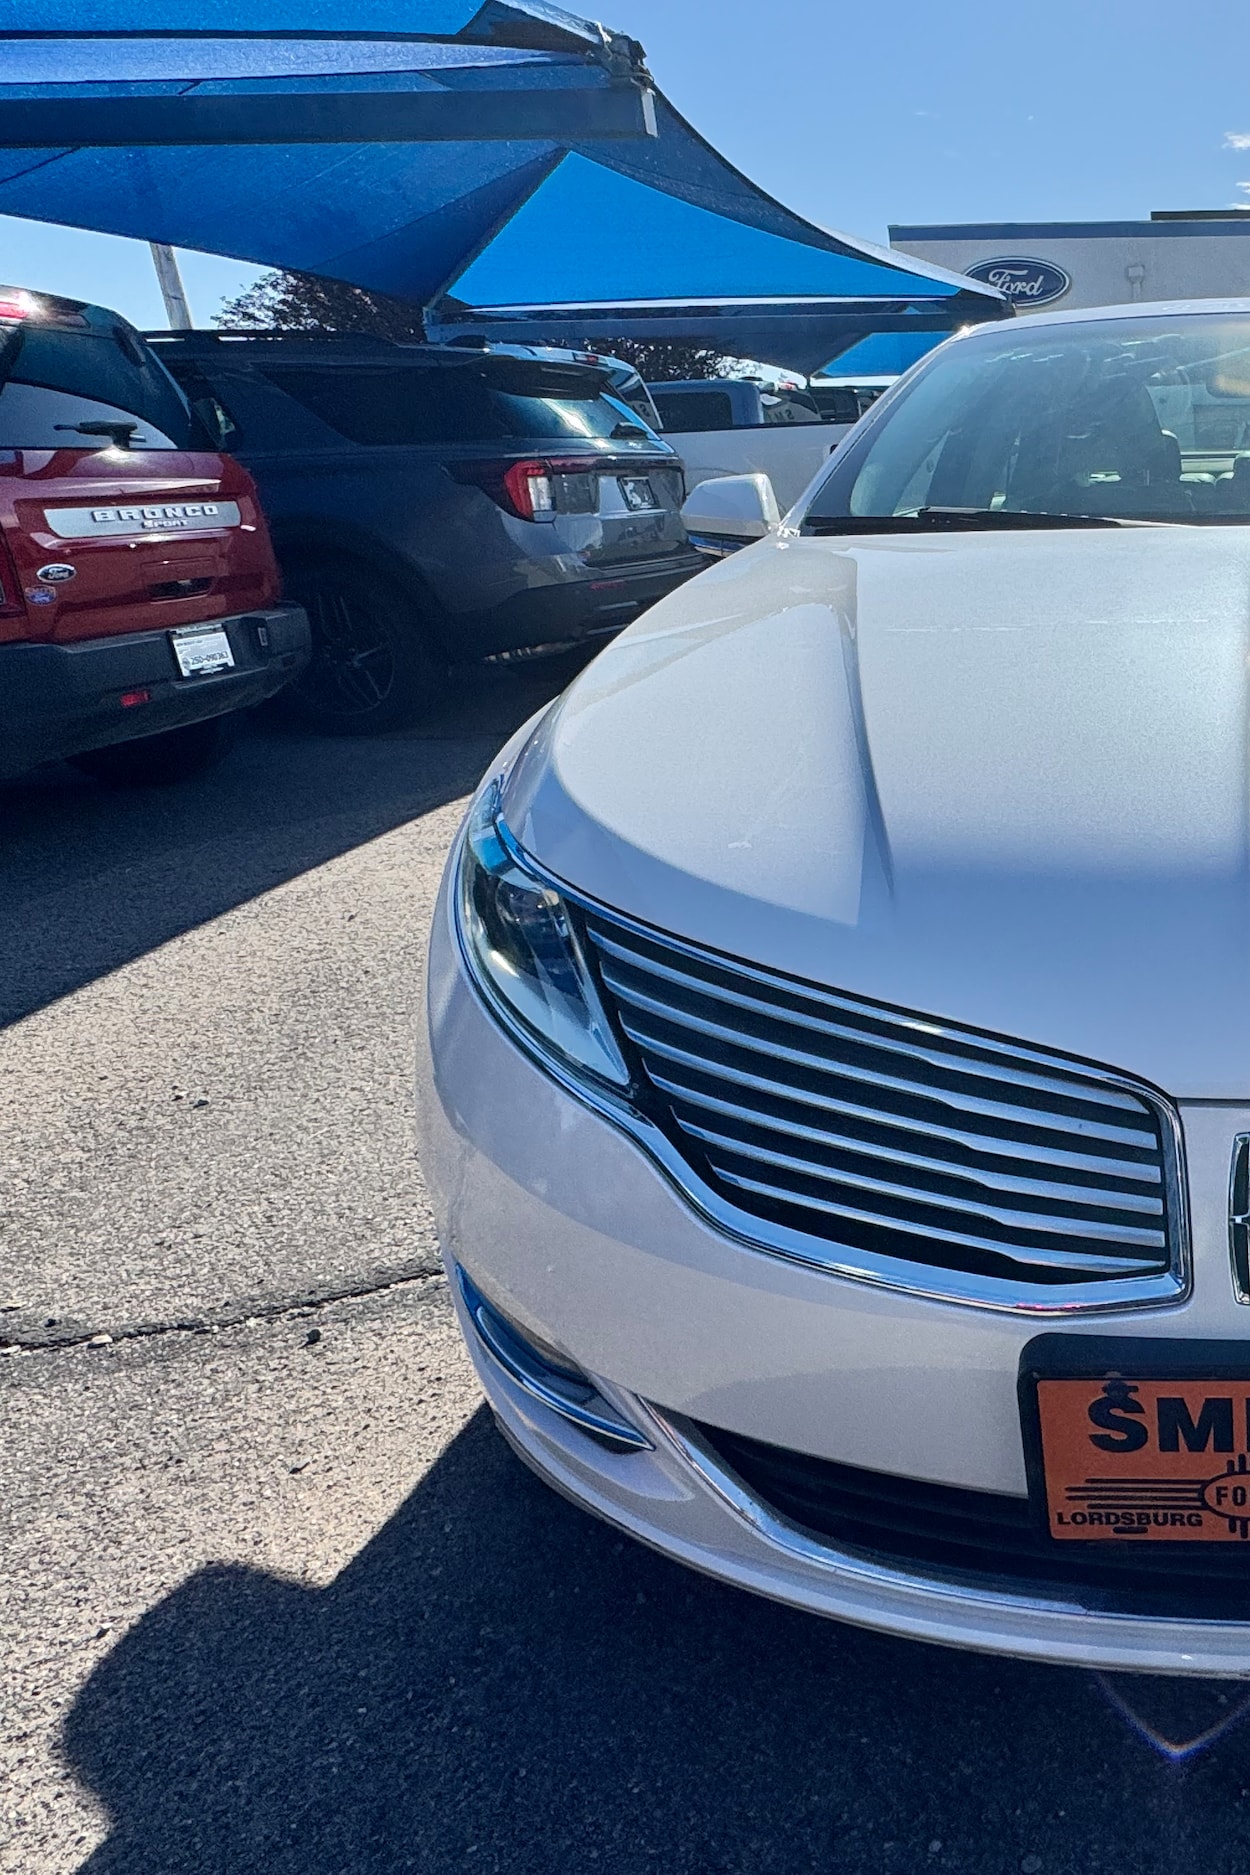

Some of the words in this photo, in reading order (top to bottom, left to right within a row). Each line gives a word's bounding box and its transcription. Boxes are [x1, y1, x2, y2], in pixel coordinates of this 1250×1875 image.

[988, 268, 1044, 296] Ford
[91, 505, 219, 523] BRONCO
[141, 519, 188, 530] SPORT
[1056, 1511, 1203, 1527] LORDSBURG
